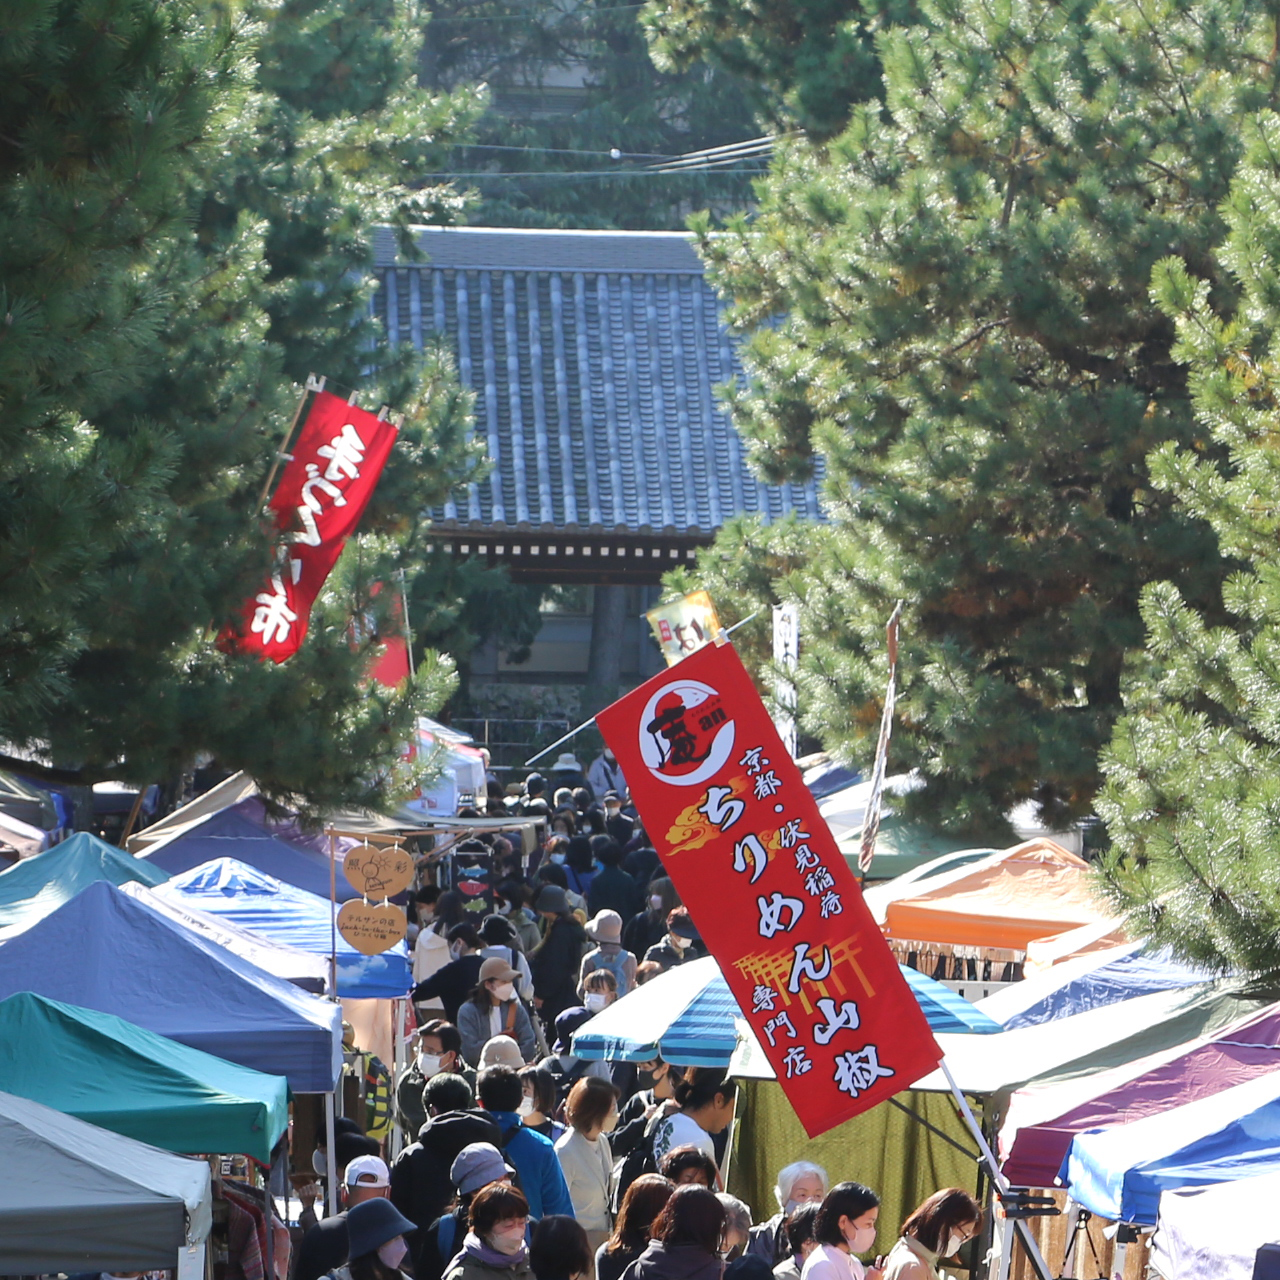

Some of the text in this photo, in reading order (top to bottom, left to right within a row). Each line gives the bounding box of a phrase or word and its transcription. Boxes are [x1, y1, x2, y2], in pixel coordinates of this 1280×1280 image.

[699, 707, 727, 731] an
[698, 785, 895, 1098] ちりめん山椒
